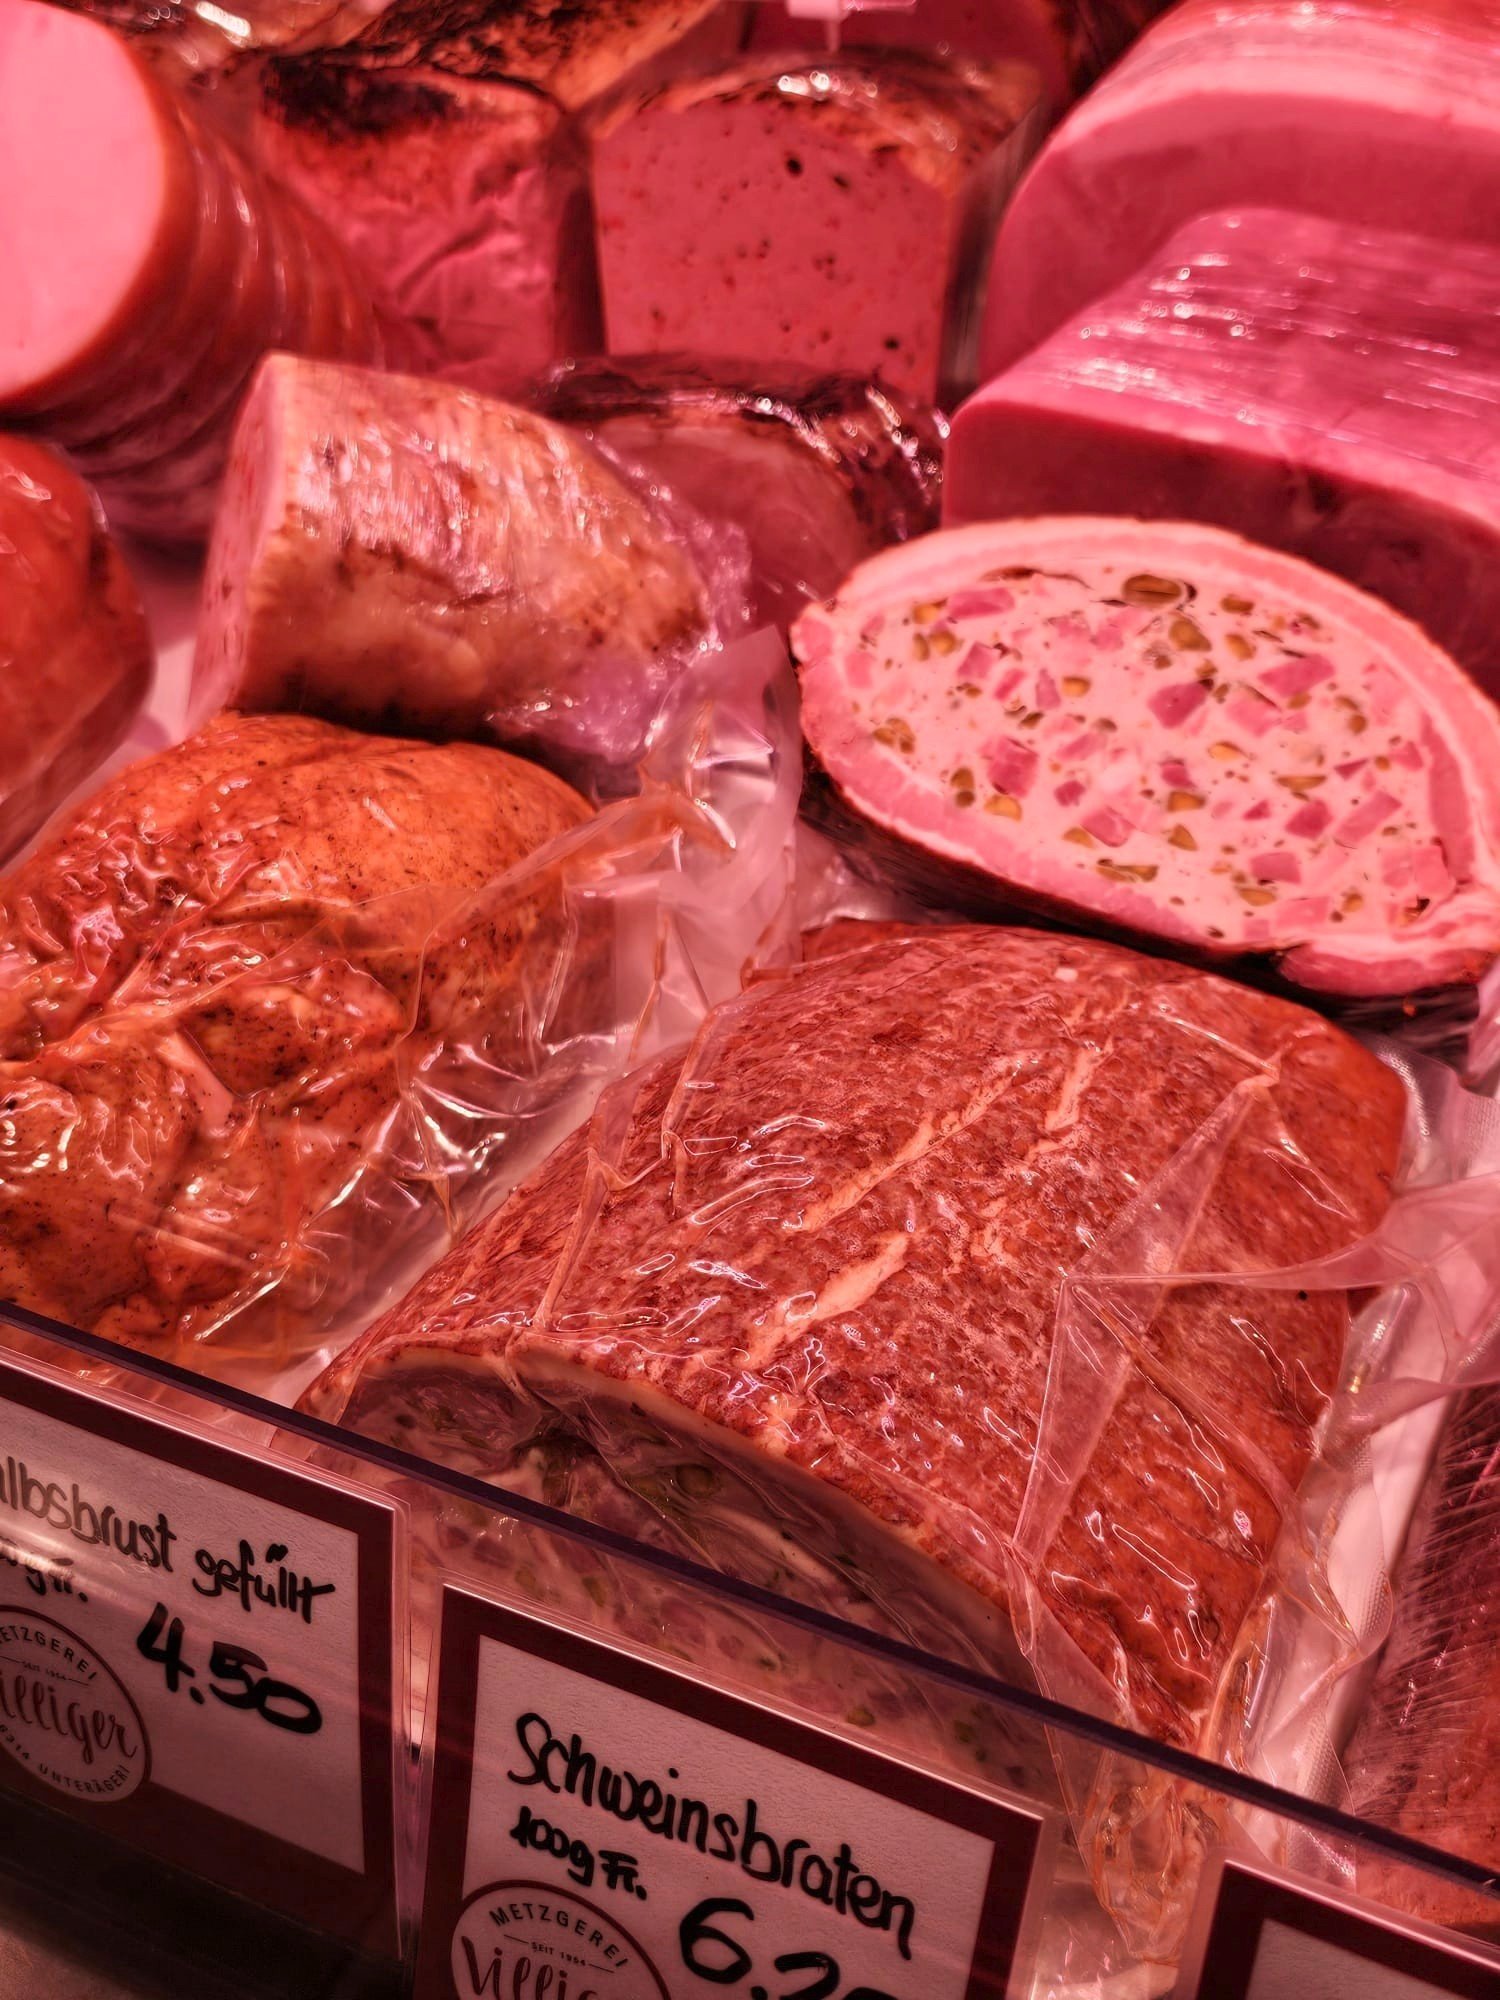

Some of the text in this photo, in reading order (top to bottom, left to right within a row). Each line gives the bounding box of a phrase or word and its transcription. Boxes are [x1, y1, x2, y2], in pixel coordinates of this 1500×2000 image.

[192, 1539, 336, 1624] gefüllt
[0, 1626, 98, 1680] ETZGEREI
[136, 1602, 323, 1734] 4.50
[0, 1673, 138, 1765] illiger
[507, 1713, 915, 1960] Schweinsbraten
[510, 1806, 595, 1887] 100g
[461, 1935, 598, 2000] Villi
[489, 1903, 628, 1967] METZGEREI
[531, 1942, 555, 1956] SEIT
[679, 1897, 905, 2000] 6.2
